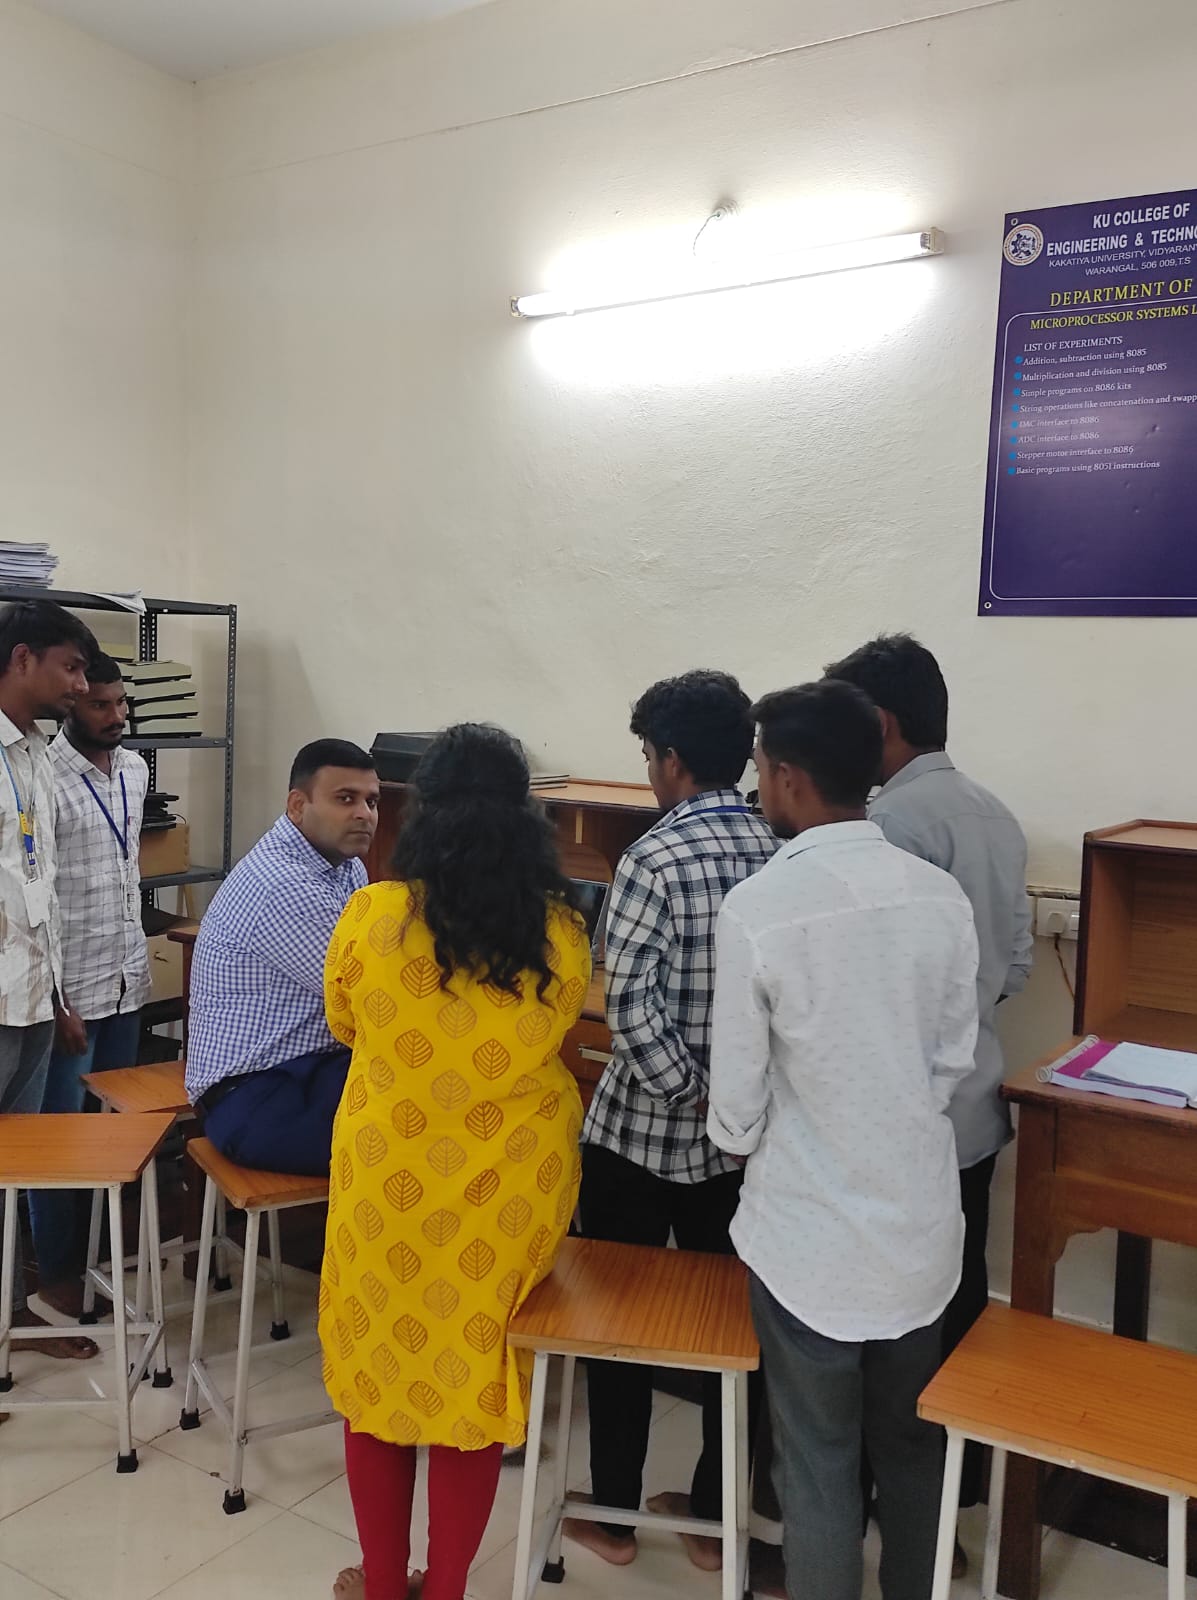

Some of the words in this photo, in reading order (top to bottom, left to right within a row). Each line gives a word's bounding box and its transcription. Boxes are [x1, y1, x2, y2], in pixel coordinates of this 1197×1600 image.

[1093, 214, 1110, 229] KU
[1114, 206, 1170, 226] COLLEGE
[1173, 203, 1190, 218] OF
[1047, 234, 1128, 256] ENGINEERING
[1134, 232, 1143, 246] &
[1049, 256, 1089, 267] KAKATIYA
[1141, 262, 1157, 270] 506
[1050, 281, 1165, 306] DEPARTMENT
[1169, 279, 1193, 294] OF
[1030, 310, 1134, 329] MICROPROCESSOR
[1136, 304, 1190, 320] SYSTEMS
[1024, 344, 1042, 352] LIST
[1044, 342, 1057, 350] OF
[1059, 336, 1123, 349] EXPERIMENTS
[1060, 353, 1101, 363] subtraction
[1104, 351, 1124, 360] using
[1126, 349, 1147, 357] 8085
[1022, 371, 1074, 382] Multiplication
[1076, 369, 1090, 377] and
[1092, 367, 1122, 376] division
[1124, 365, 1145, 374] using
[1147, 363, 1167, 371] 8085
[1021, 388, 1046, 398] Simple
[1048, 386, 1082, 397] programs
[1095, 383, 1116, 392] 8086
[1117, 382, 1132, 390] kits
[1020, 405, 1042, 414] String
[1044, 401, 1083, 412] operations
[1084, 400, 1098, 409] like
[1100, 397, 1154, 408] concatenation
[1156, 395, 1170, 403] and
[1080, 432, 1100, 440] 8086
[1017, 452, 1045, 460] Stepper
[1046, 450, 1068, 458] motor
[1070, 447, 1102, 456] interface
[1113, 446, 1134, 454] 8086
[1016, 466, 1035, 474] Basic
[1037, 465, 1070, 475] programs
[1072, 464, 1092, 472] using
[1114, 461, 1160, 470] instructions
